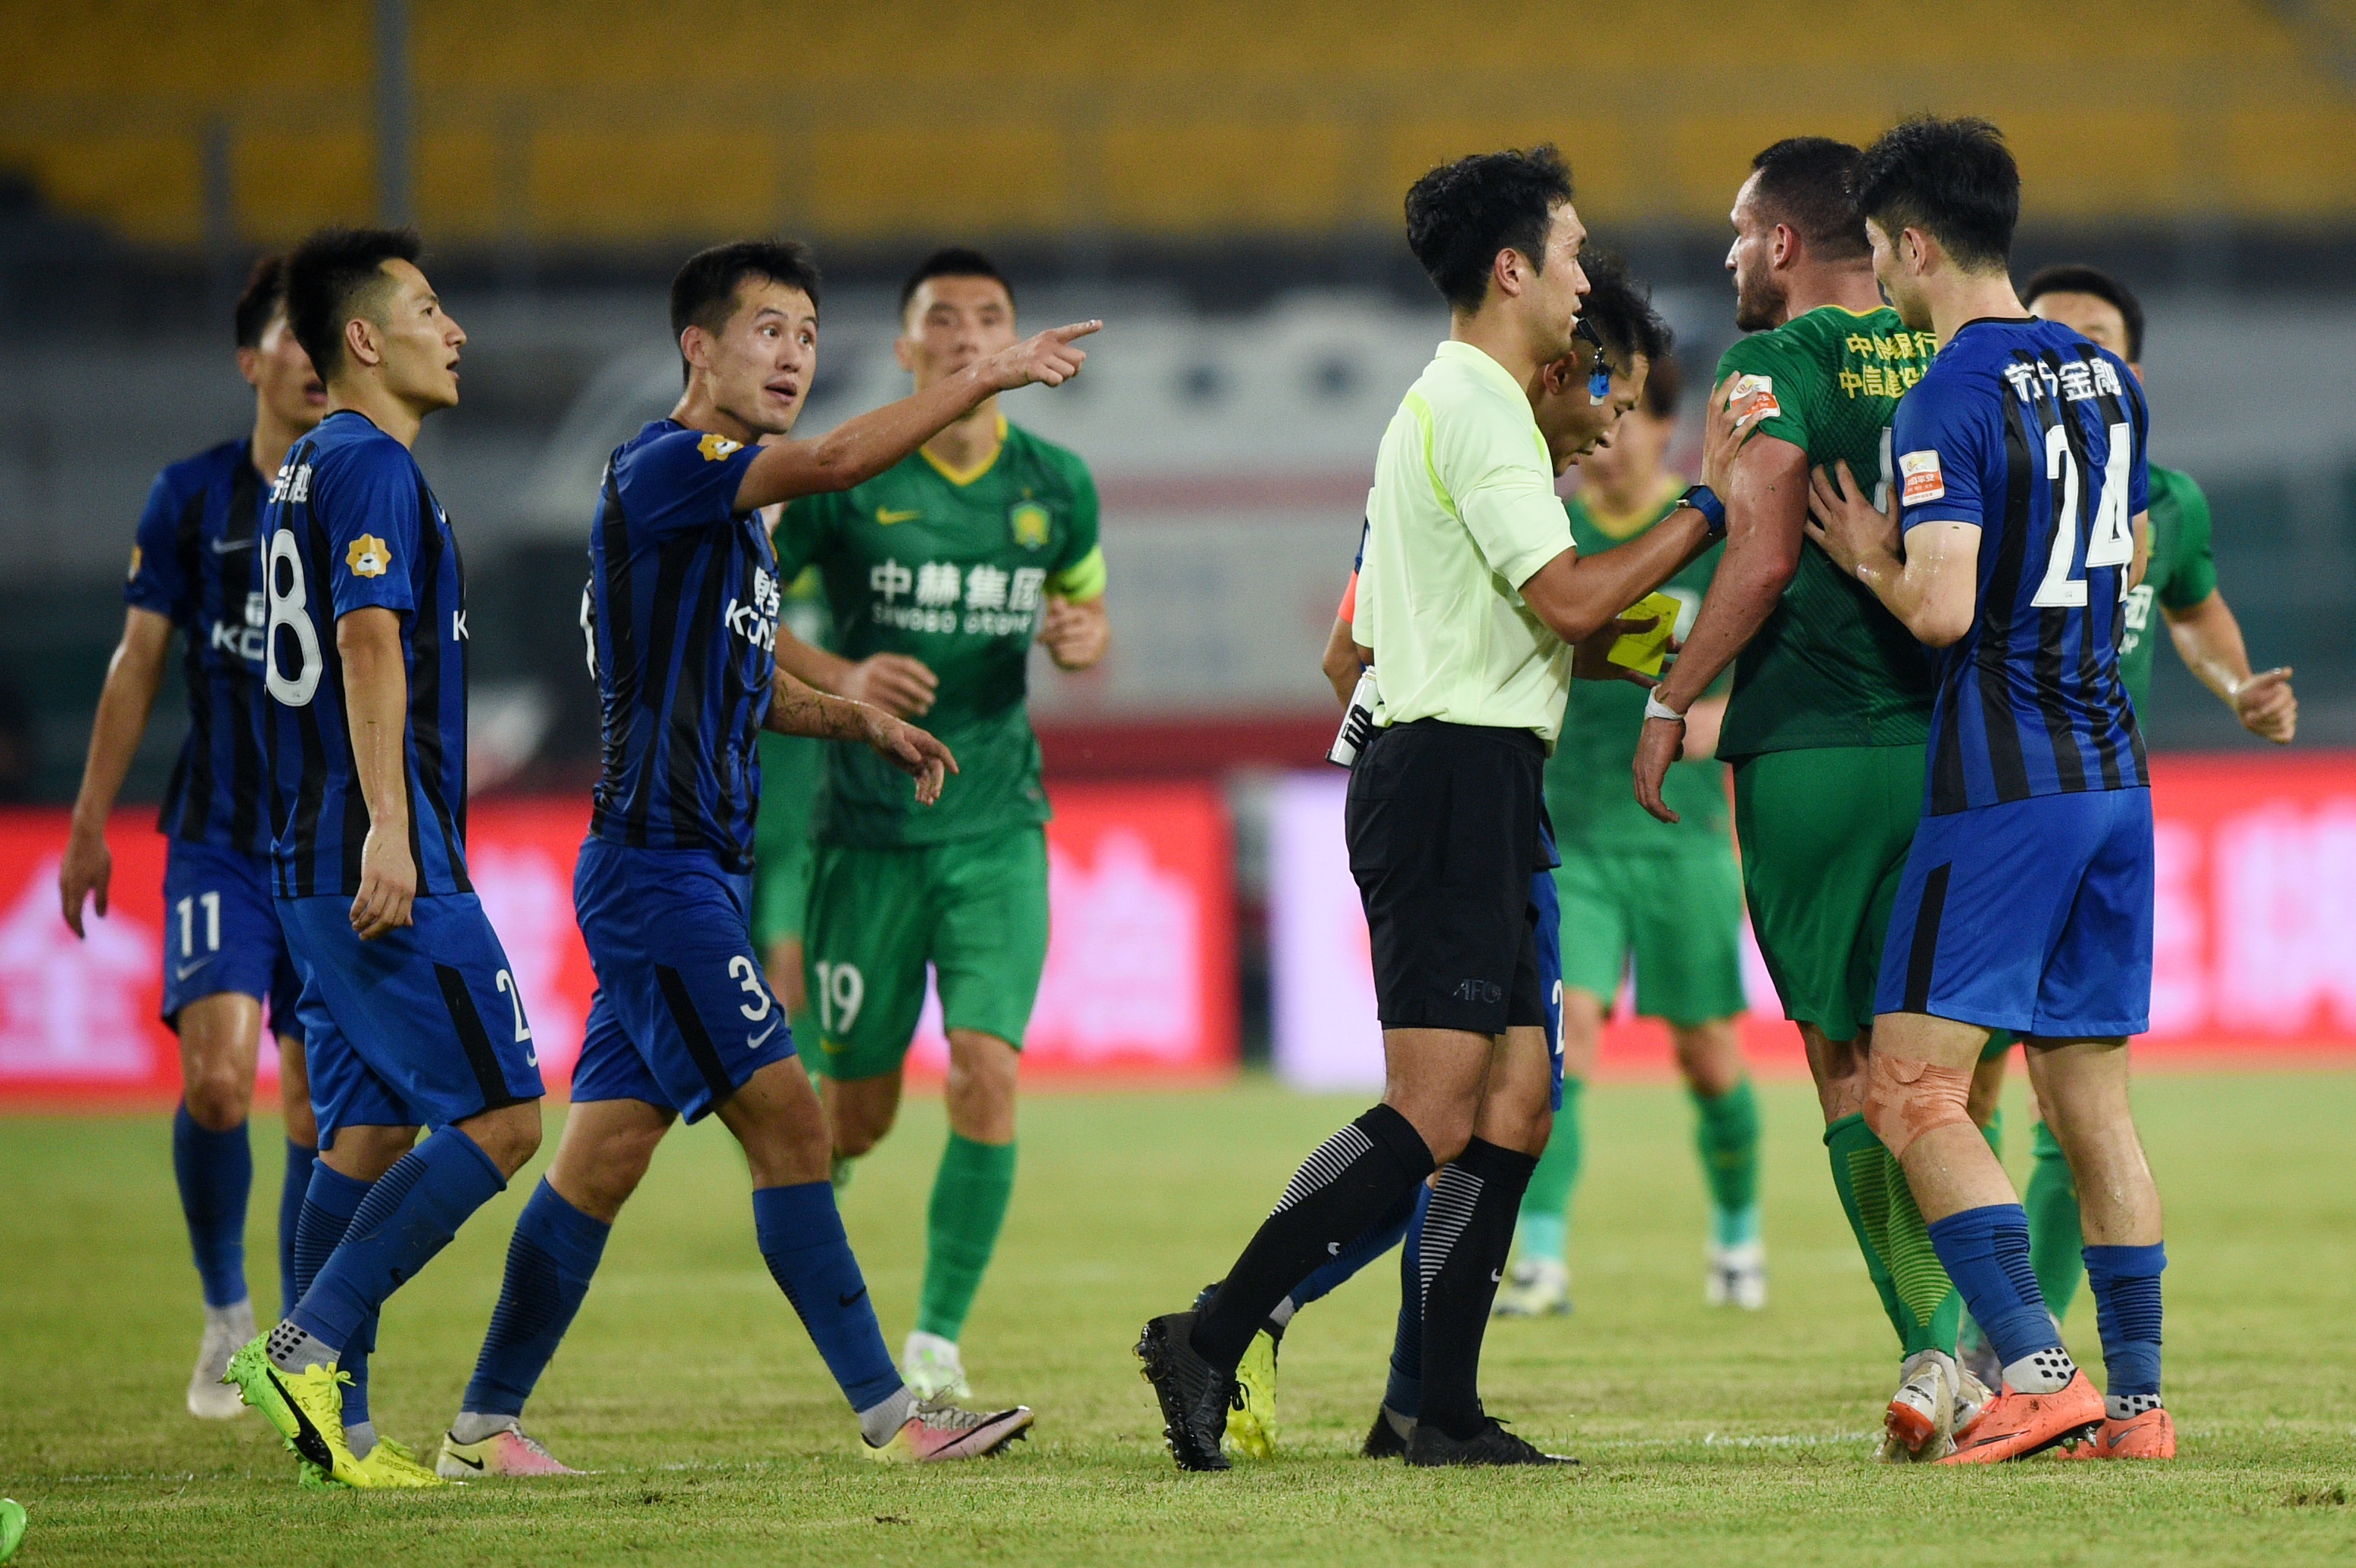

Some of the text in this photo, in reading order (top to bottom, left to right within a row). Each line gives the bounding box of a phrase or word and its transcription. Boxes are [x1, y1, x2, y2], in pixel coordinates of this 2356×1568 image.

[1838, 364, 1928, 399] 中信建投
[2030, 422, 2133, 607] 24
[261, 528, 323, 707] 8
[871, 558, 1046, 612] 中赫集团
[176, 890, 220, 958] 11
[728, 955, 771, 1021] 3
[815, 962, 864, 1033] 19
